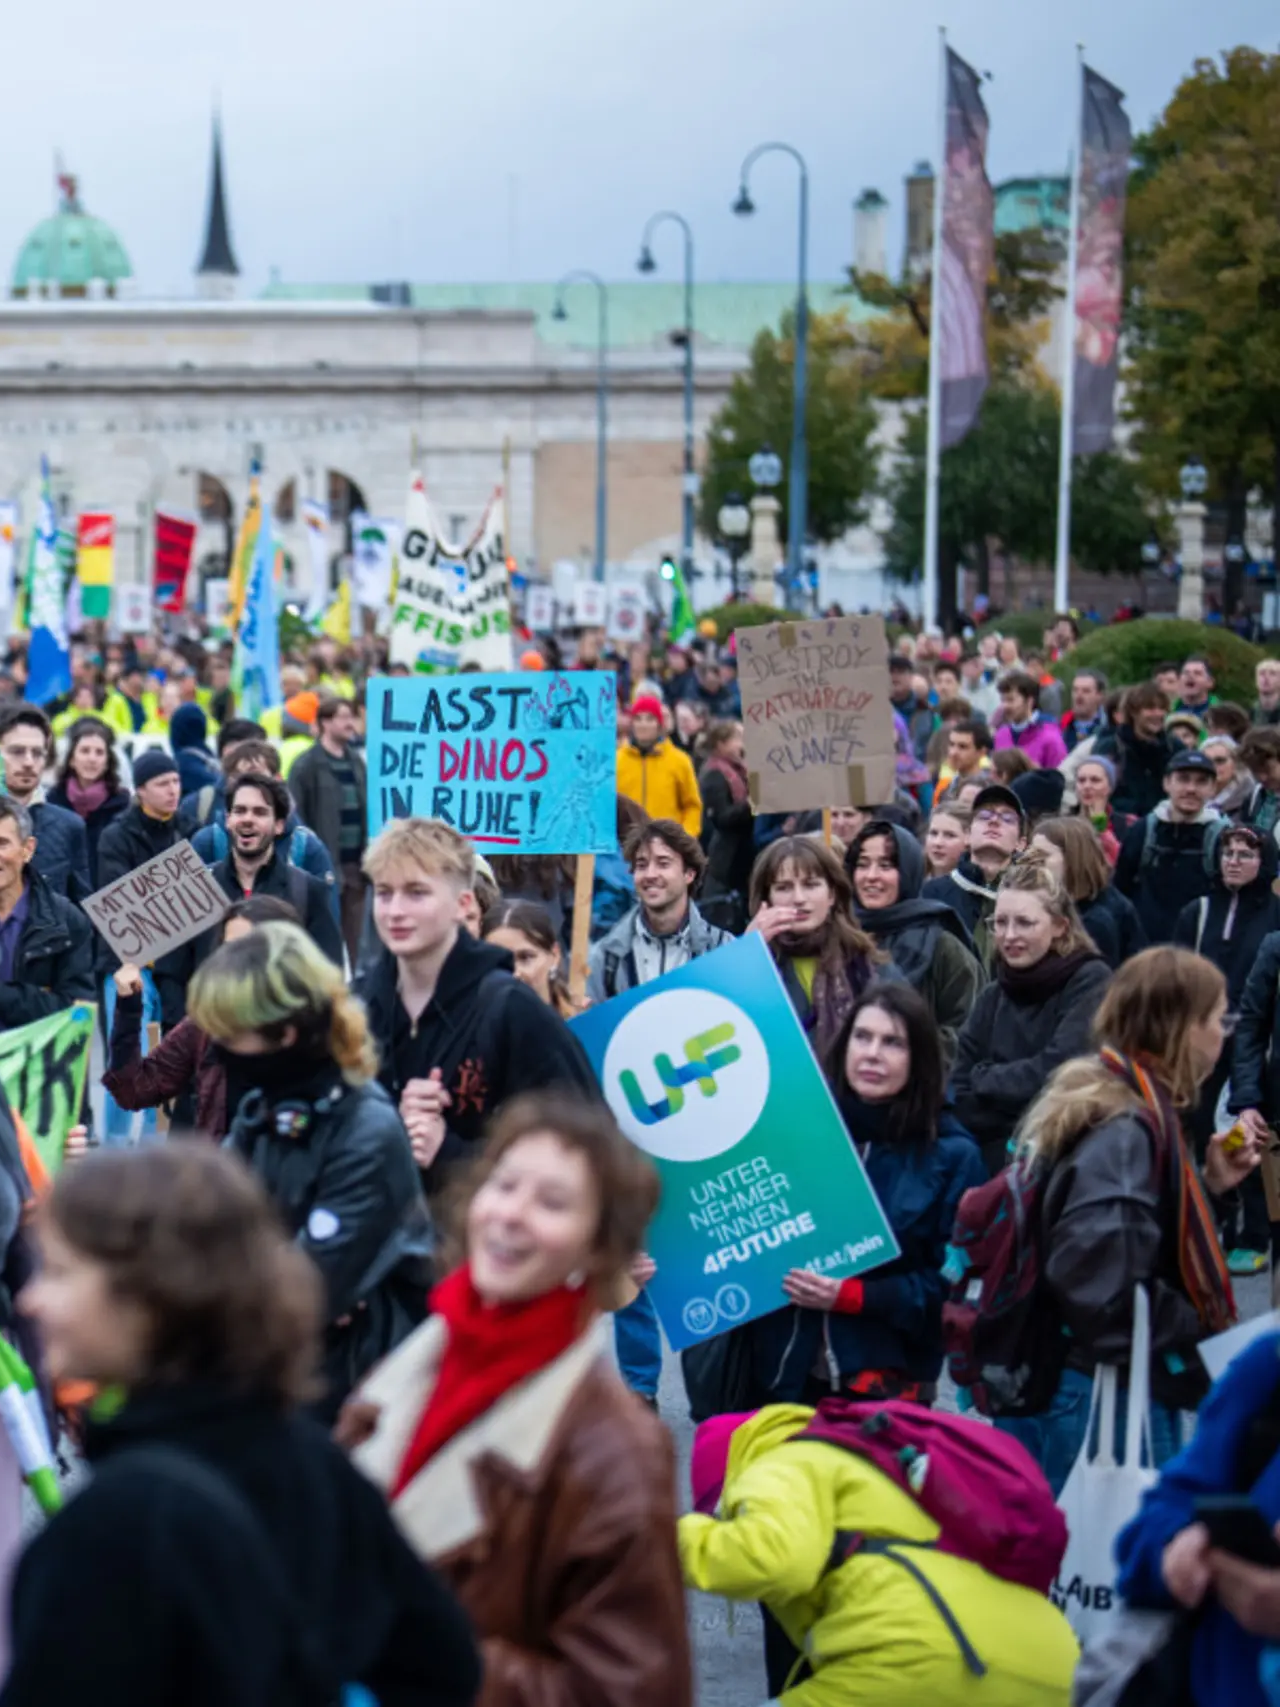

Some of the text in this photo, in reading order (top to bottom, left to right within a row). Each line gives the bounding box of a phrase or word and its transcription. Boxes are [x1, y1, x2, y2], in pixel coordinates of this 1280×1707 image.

[747, 643, 873, 685] DESTROY
[792, 671, 830, 689] THE
[381, 686, 532, 734] LASST
[746, 685, 874, 725] PATRIARCHY
[778, 712, 817, 742] NOT
[380, 737, 549, 783] DIE DINOS
[766, 737, 866, 774] PLANET
[381, 785, 543, 835] IN RUHE!
[91, 848, 200, 921] MIT UNS DIE
[108, 870, 227, 958] SINTFLUT
[688, 1172, 792, 1231] NEHMER
[689, 1156, 772, 1205] UNTER
[702, 1210, 817, 1275] 4FUTURE
